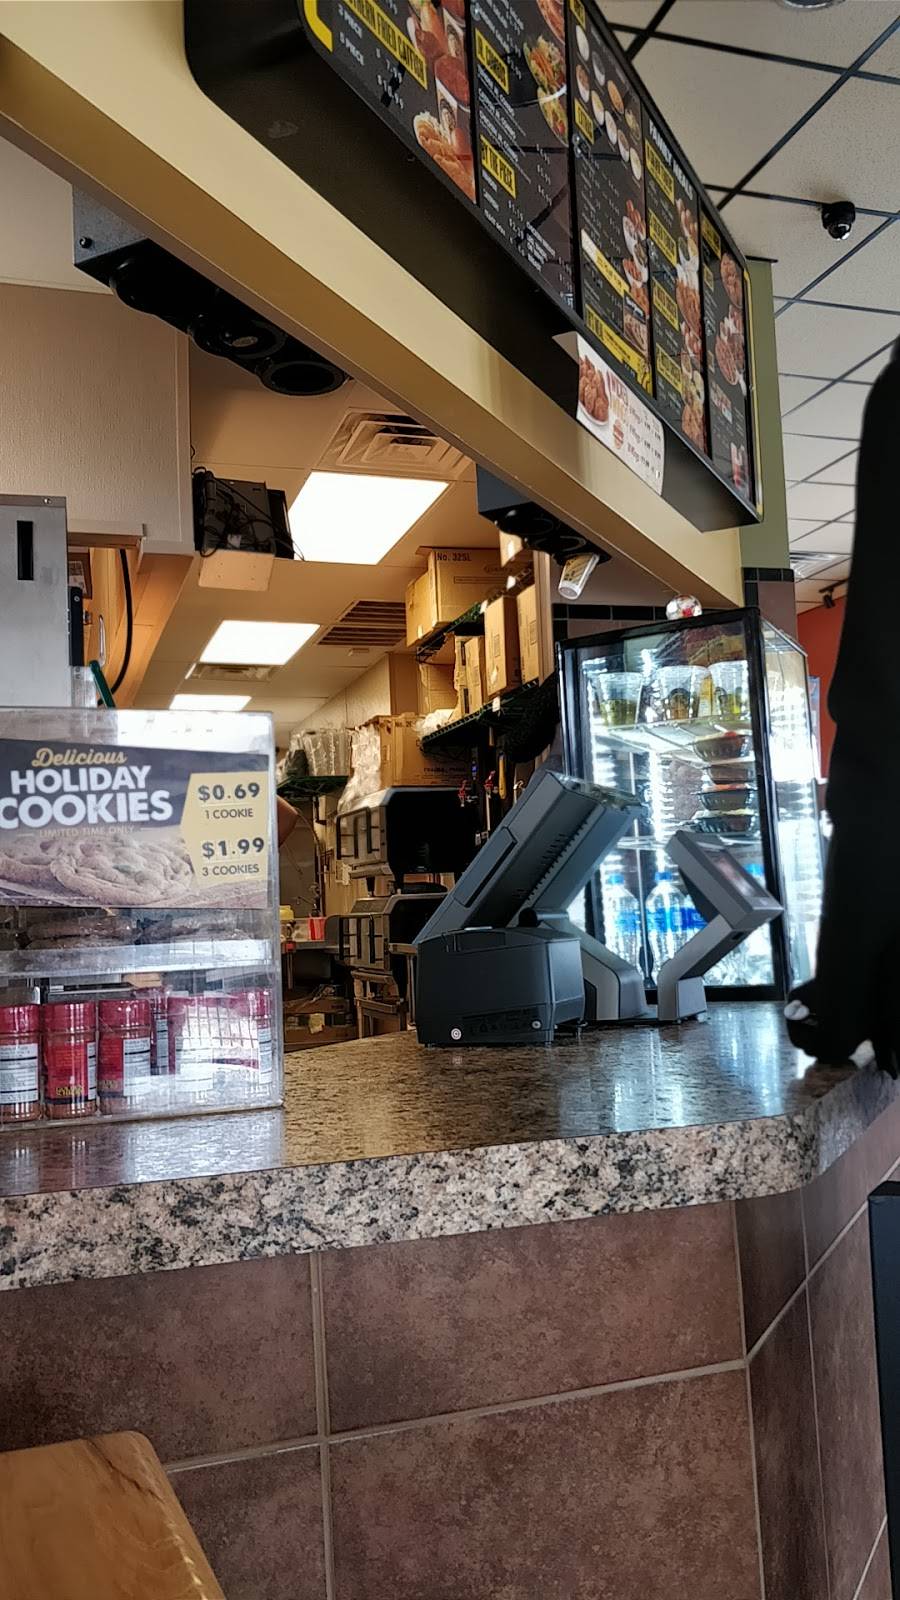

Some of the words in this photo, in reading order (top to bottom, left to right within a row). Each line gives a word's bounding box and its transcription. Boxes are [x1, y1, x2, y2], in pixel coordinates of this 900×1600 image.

[649, 118, 673, 166] FAMILY
[673, 159, 693, 201] MEALS
[437, 552, 451, 561] No.
[31, 748, 128, 768] Delicious
[10, 765, 151, 795] HOLIDAY
[197, 782, 261, 803] $0.69
[0, 790, 174, 829] COOKIES
[205, 810, 210, 819] 1
[212, 807, 254, 819] COOKIE
[39, 828, 79, 838] LIMITED
[83, 826, 106, 836] TIME
[108, 825, 134, 834] ONLY
[201, 837, 265, 859] $1.99
[202, 866, 209, 877] 3
[212, 864, 260, 876] COOKIES
